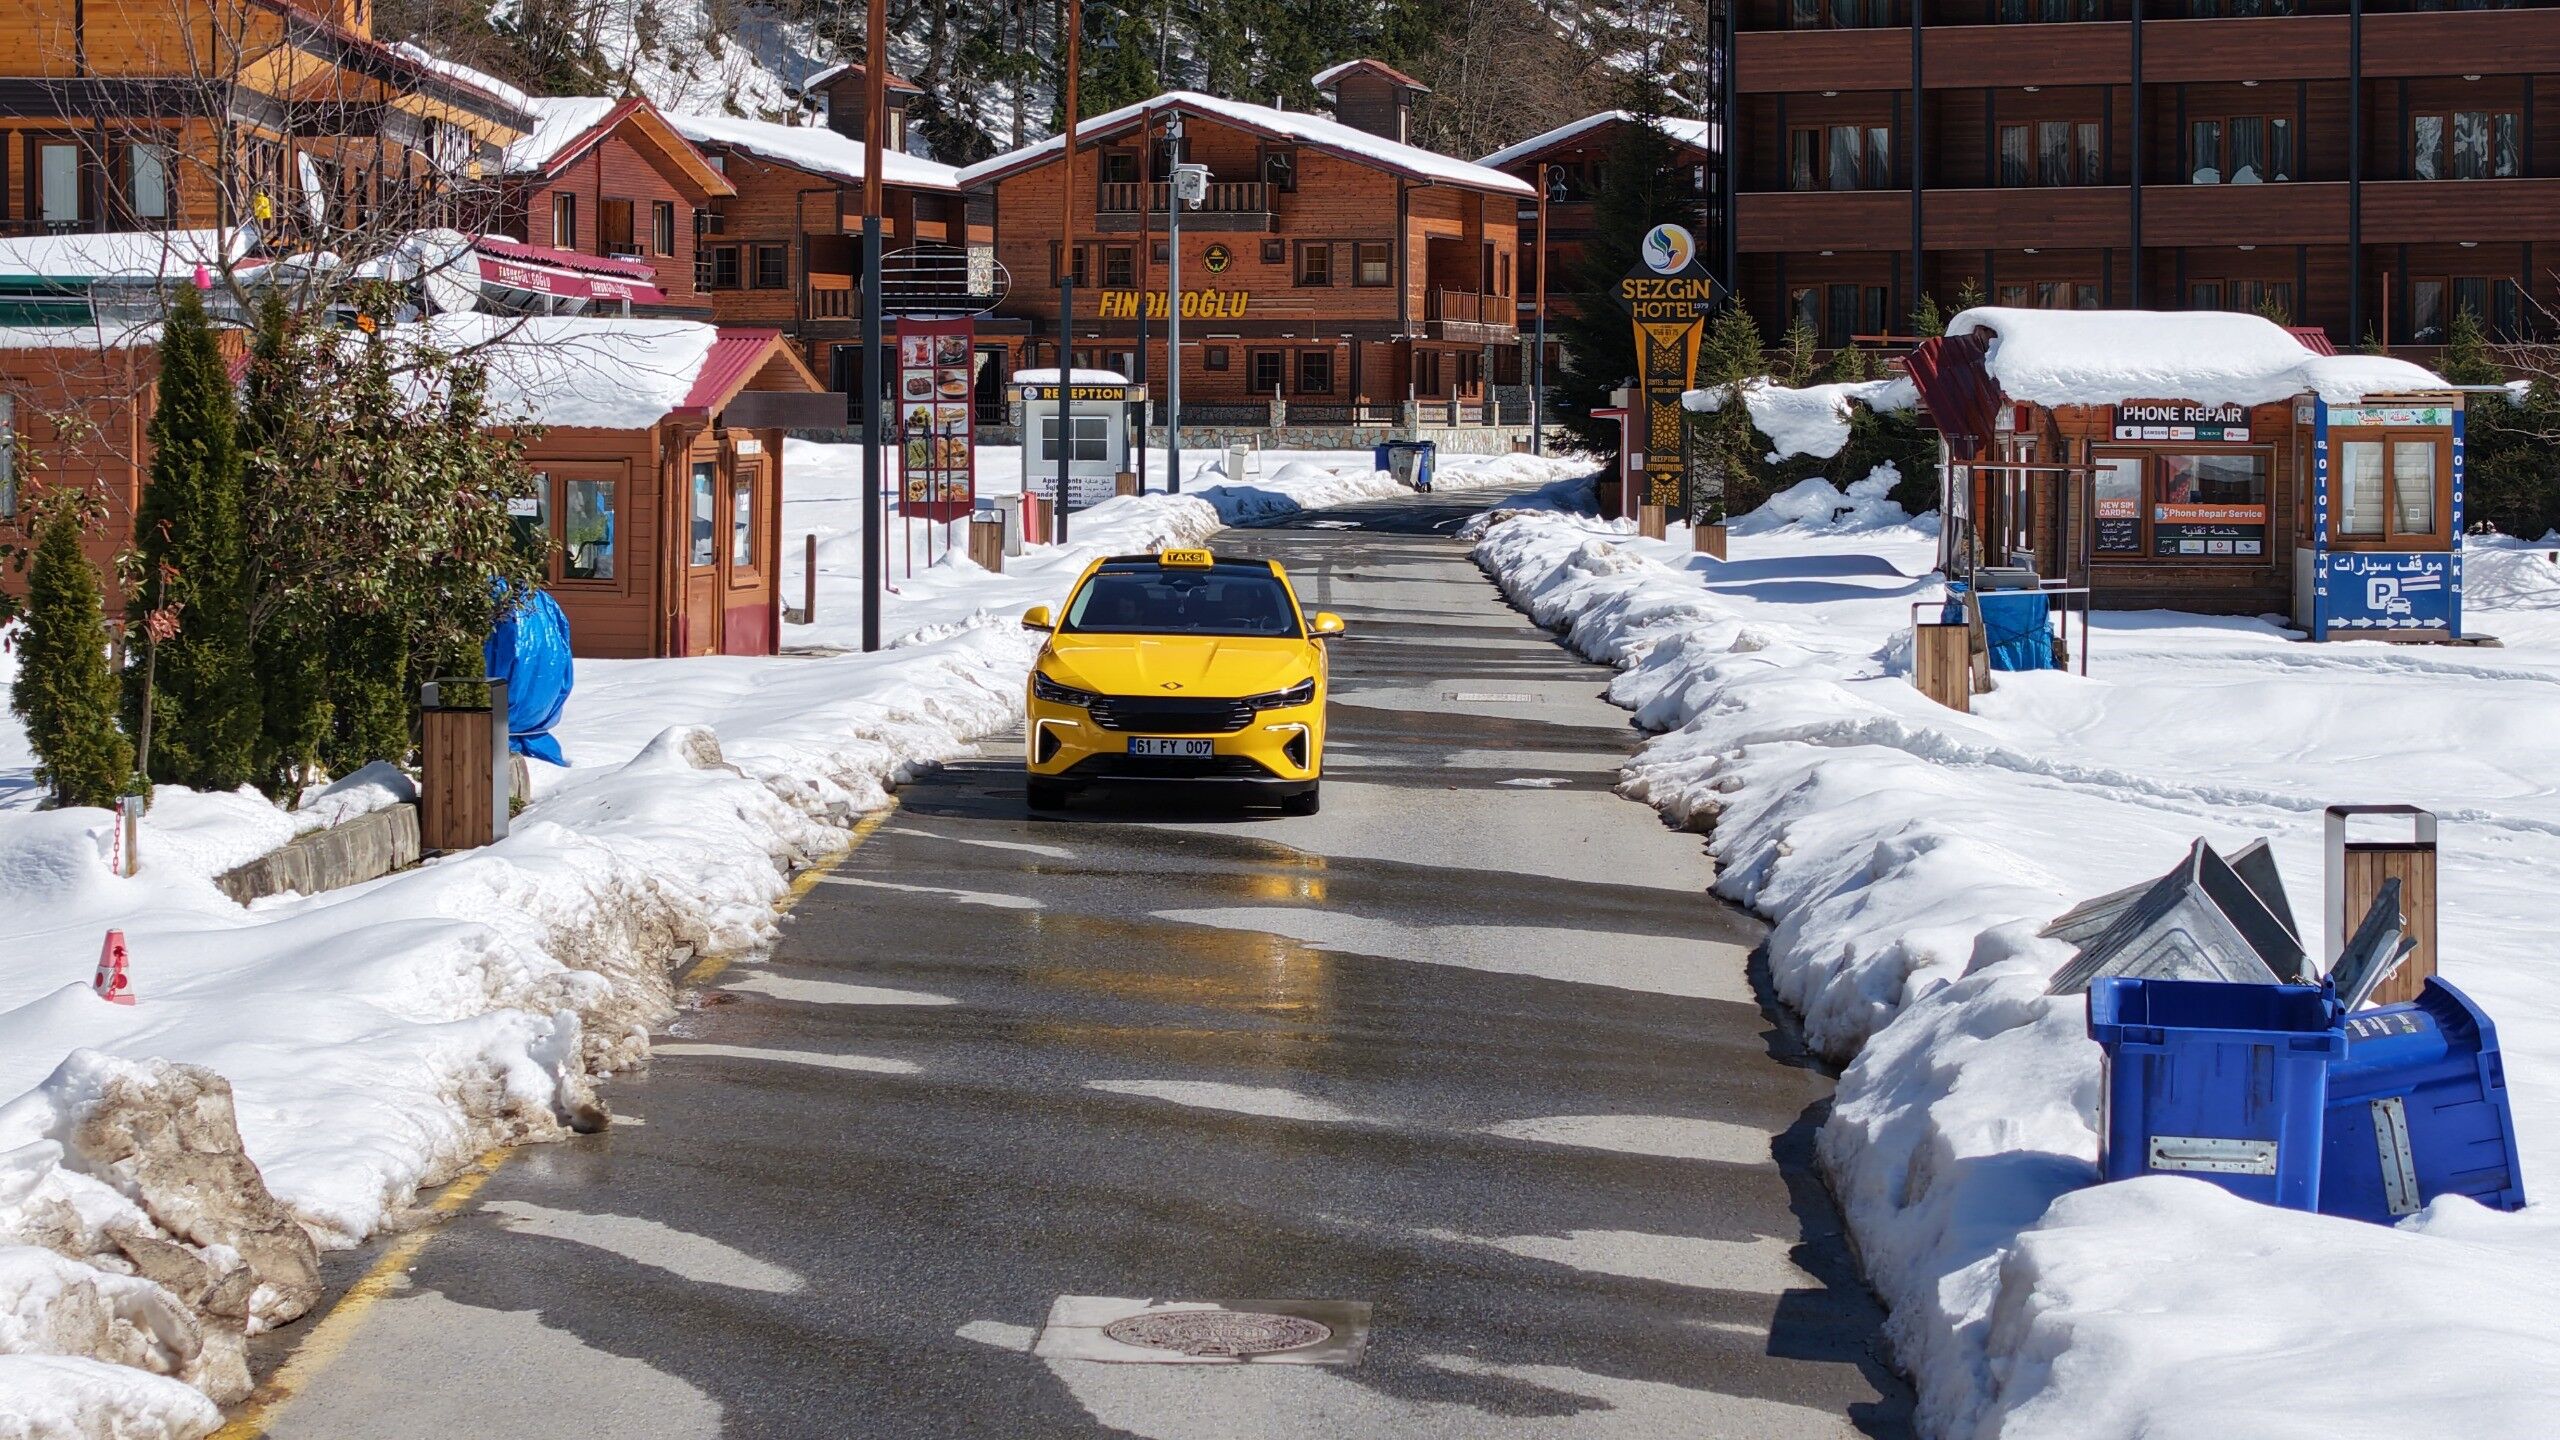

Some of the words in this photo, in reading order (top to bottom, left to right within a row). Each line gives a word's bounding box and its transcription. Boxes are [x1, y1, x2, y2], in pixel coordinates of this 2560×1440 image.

[1632, 301, 1699, 318] HOTEL
[1043, 388, 1123, 399] REEPTION
[2123, 406, 2180, 421] PHONE
[2184, 406, 2242, 422] REPAIR
[2100, 501, 2119, 509] NEW
[2120, 501, 2134, 509] SIM
[2169, 508, 2197, 517] Phone
[2198, 509, 2227, 519] Repair
[2228, 509, 2262, 518] Service
[2209, 525, 2239, 535] خدمة
[2334, 556, 2391, 576] سيارات
[2396, 555, 2443, 576] موقف
[1137, 739, 1151, 753] 61
[1160, 740, 1177, 753] FY
[1186, 741, 1211, 754] 007
